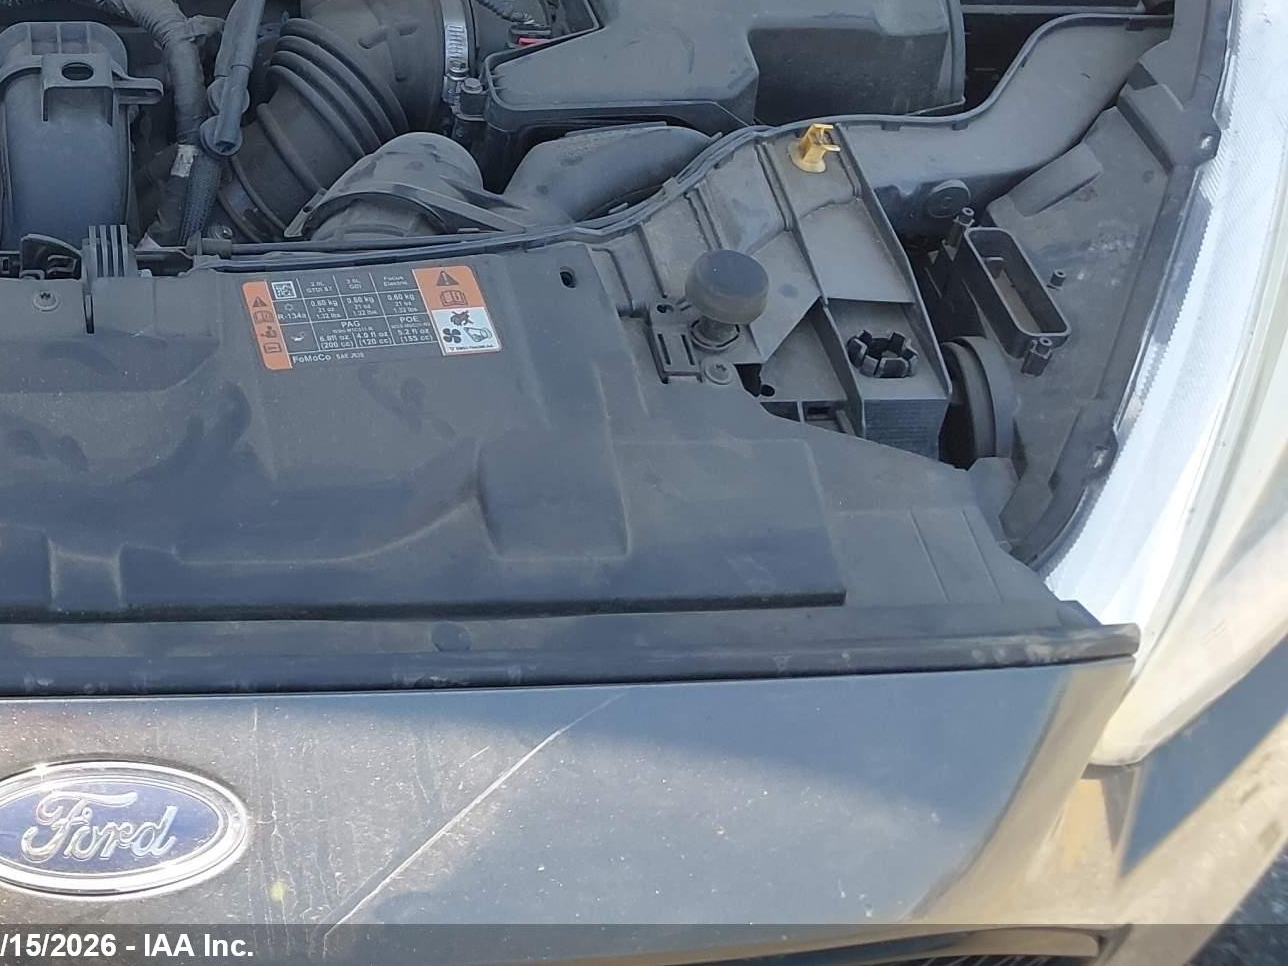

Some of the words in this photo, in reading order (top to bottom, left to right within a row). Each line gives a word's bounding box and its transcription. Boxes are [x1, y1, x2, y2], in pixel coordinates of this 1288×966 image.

[364, 296, 375, 304] kg
[404, 293, 415, 301] kg
[327, 298, 339, 307] kg
[359, 338, 377, 346] (120
[378, 337, 392, 345] cc)
[420, 334, 433, 342] cc)
[320, 342, 339, 351] (200
[340, 340, 354, 348] cc)
[292, 353, 331, 364] FoMoCo
[20, 789, 178, 862] Ford
